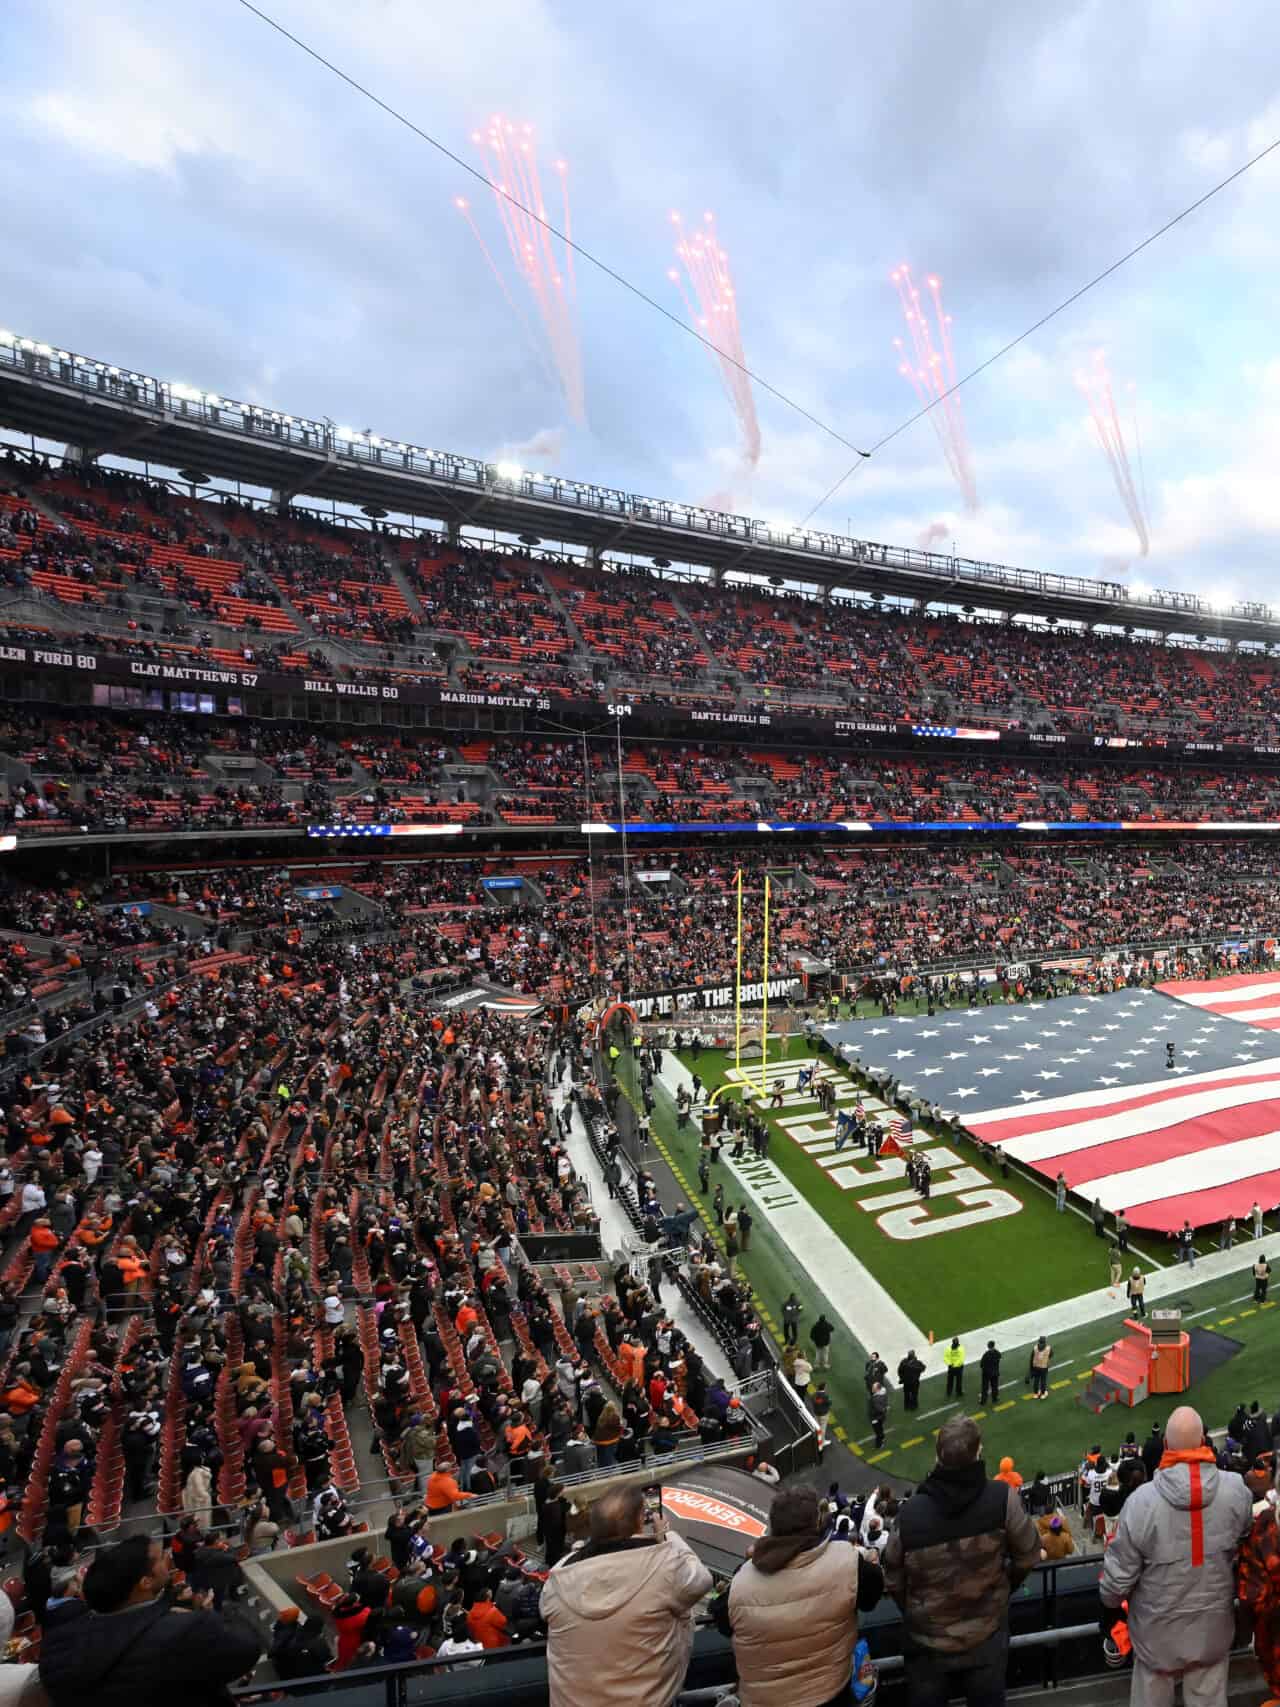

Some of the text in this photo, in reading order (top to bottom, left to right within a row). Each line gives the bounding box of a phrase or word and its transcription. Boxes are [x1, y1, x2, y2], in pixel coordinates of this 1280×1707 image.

[33, 650, 73, 666] FORD
[77, 655, 97, 670] 80
[131, 662, 258, 687] CLAY MATTHEWS 57
[304, 680, 399, 699] BILL WILLIS 60
[440, 692, 485, 705] MARION
[487, 695, 533, 709] MOTLEY
[722, 713, 757, 724] LAVELLI
[702, 987, 734, 1008] THE
[663, 1490, 746, 1527] SERVPRO
